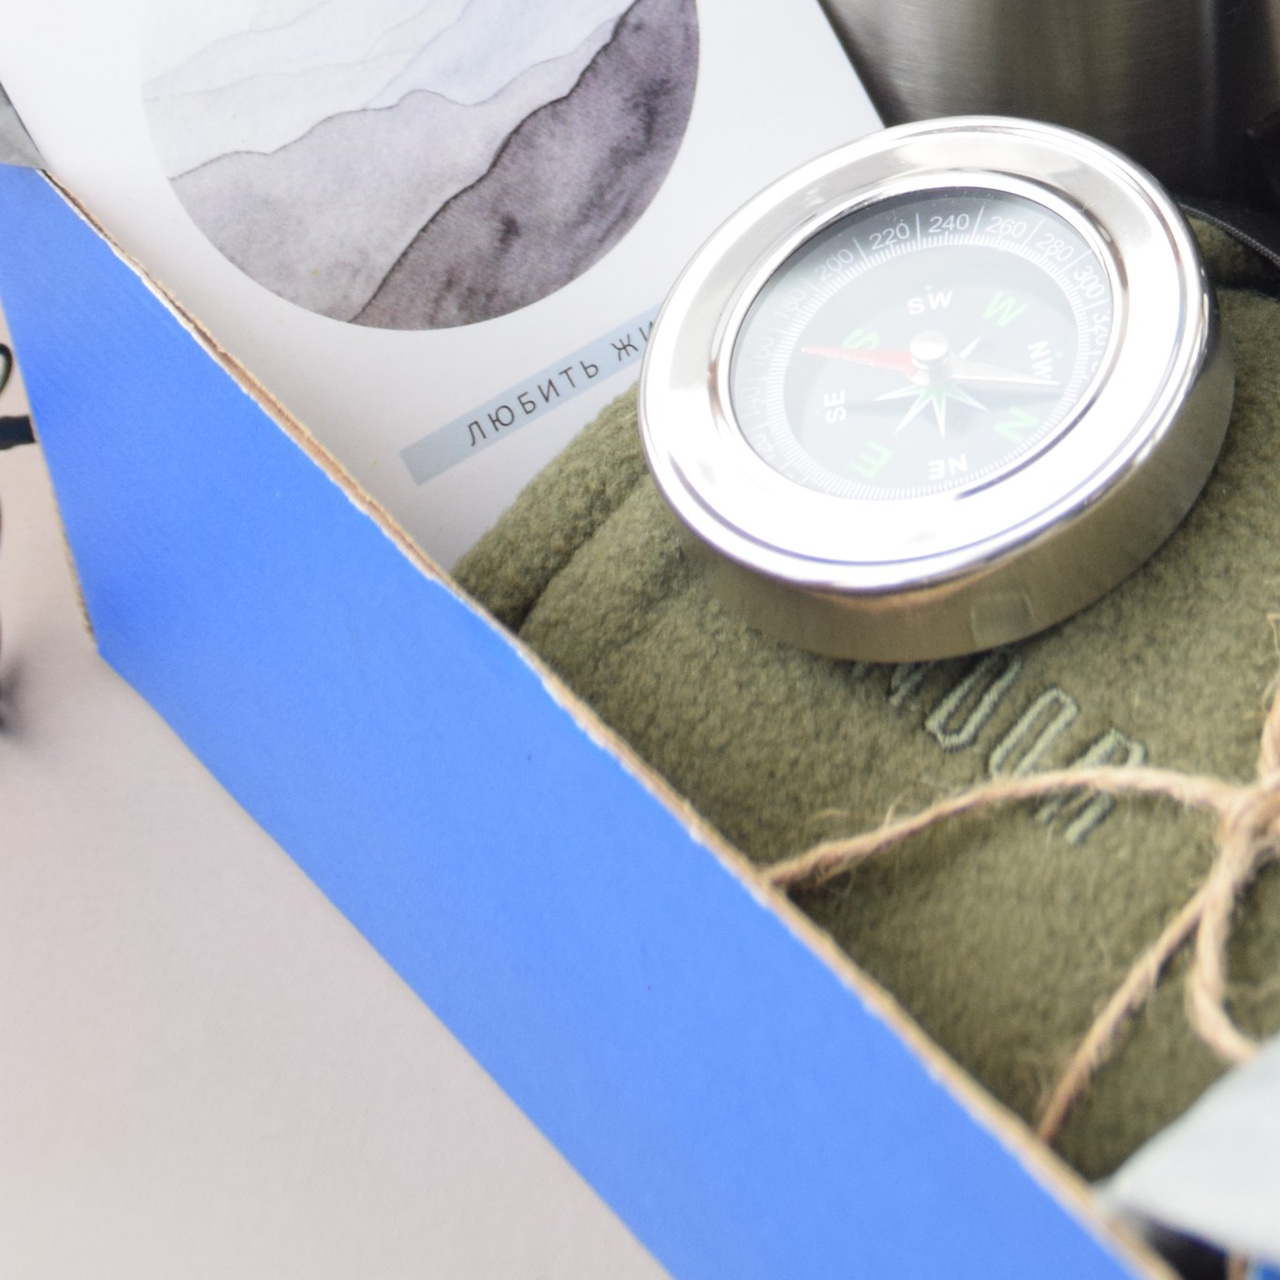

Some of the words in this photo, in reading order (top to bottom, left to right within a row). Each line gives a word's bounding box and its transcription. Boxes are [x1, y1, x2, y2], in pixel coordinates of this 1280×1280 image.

[869, 222, 910, 251] 220
[928, 214, 970, 233] 240
[985, 216, 1028, 238] 260
[1036, 232, 1074, 262] 280
[814, 248, 854, 281] 200
[1073, 266, 1104, 300] 300
[907, 290, 952, 315] SW
[982, 289, 1029, 327] W
[1027, 339, 1054, 379] NW
[467, 360, 600, 447] ЛЮБИТЬ
[823, 390, 847, 424] SE
[992, 406, 1038, 444] N
[849, 439, 894, 480] E
[928, 453, 968, 481] NE
